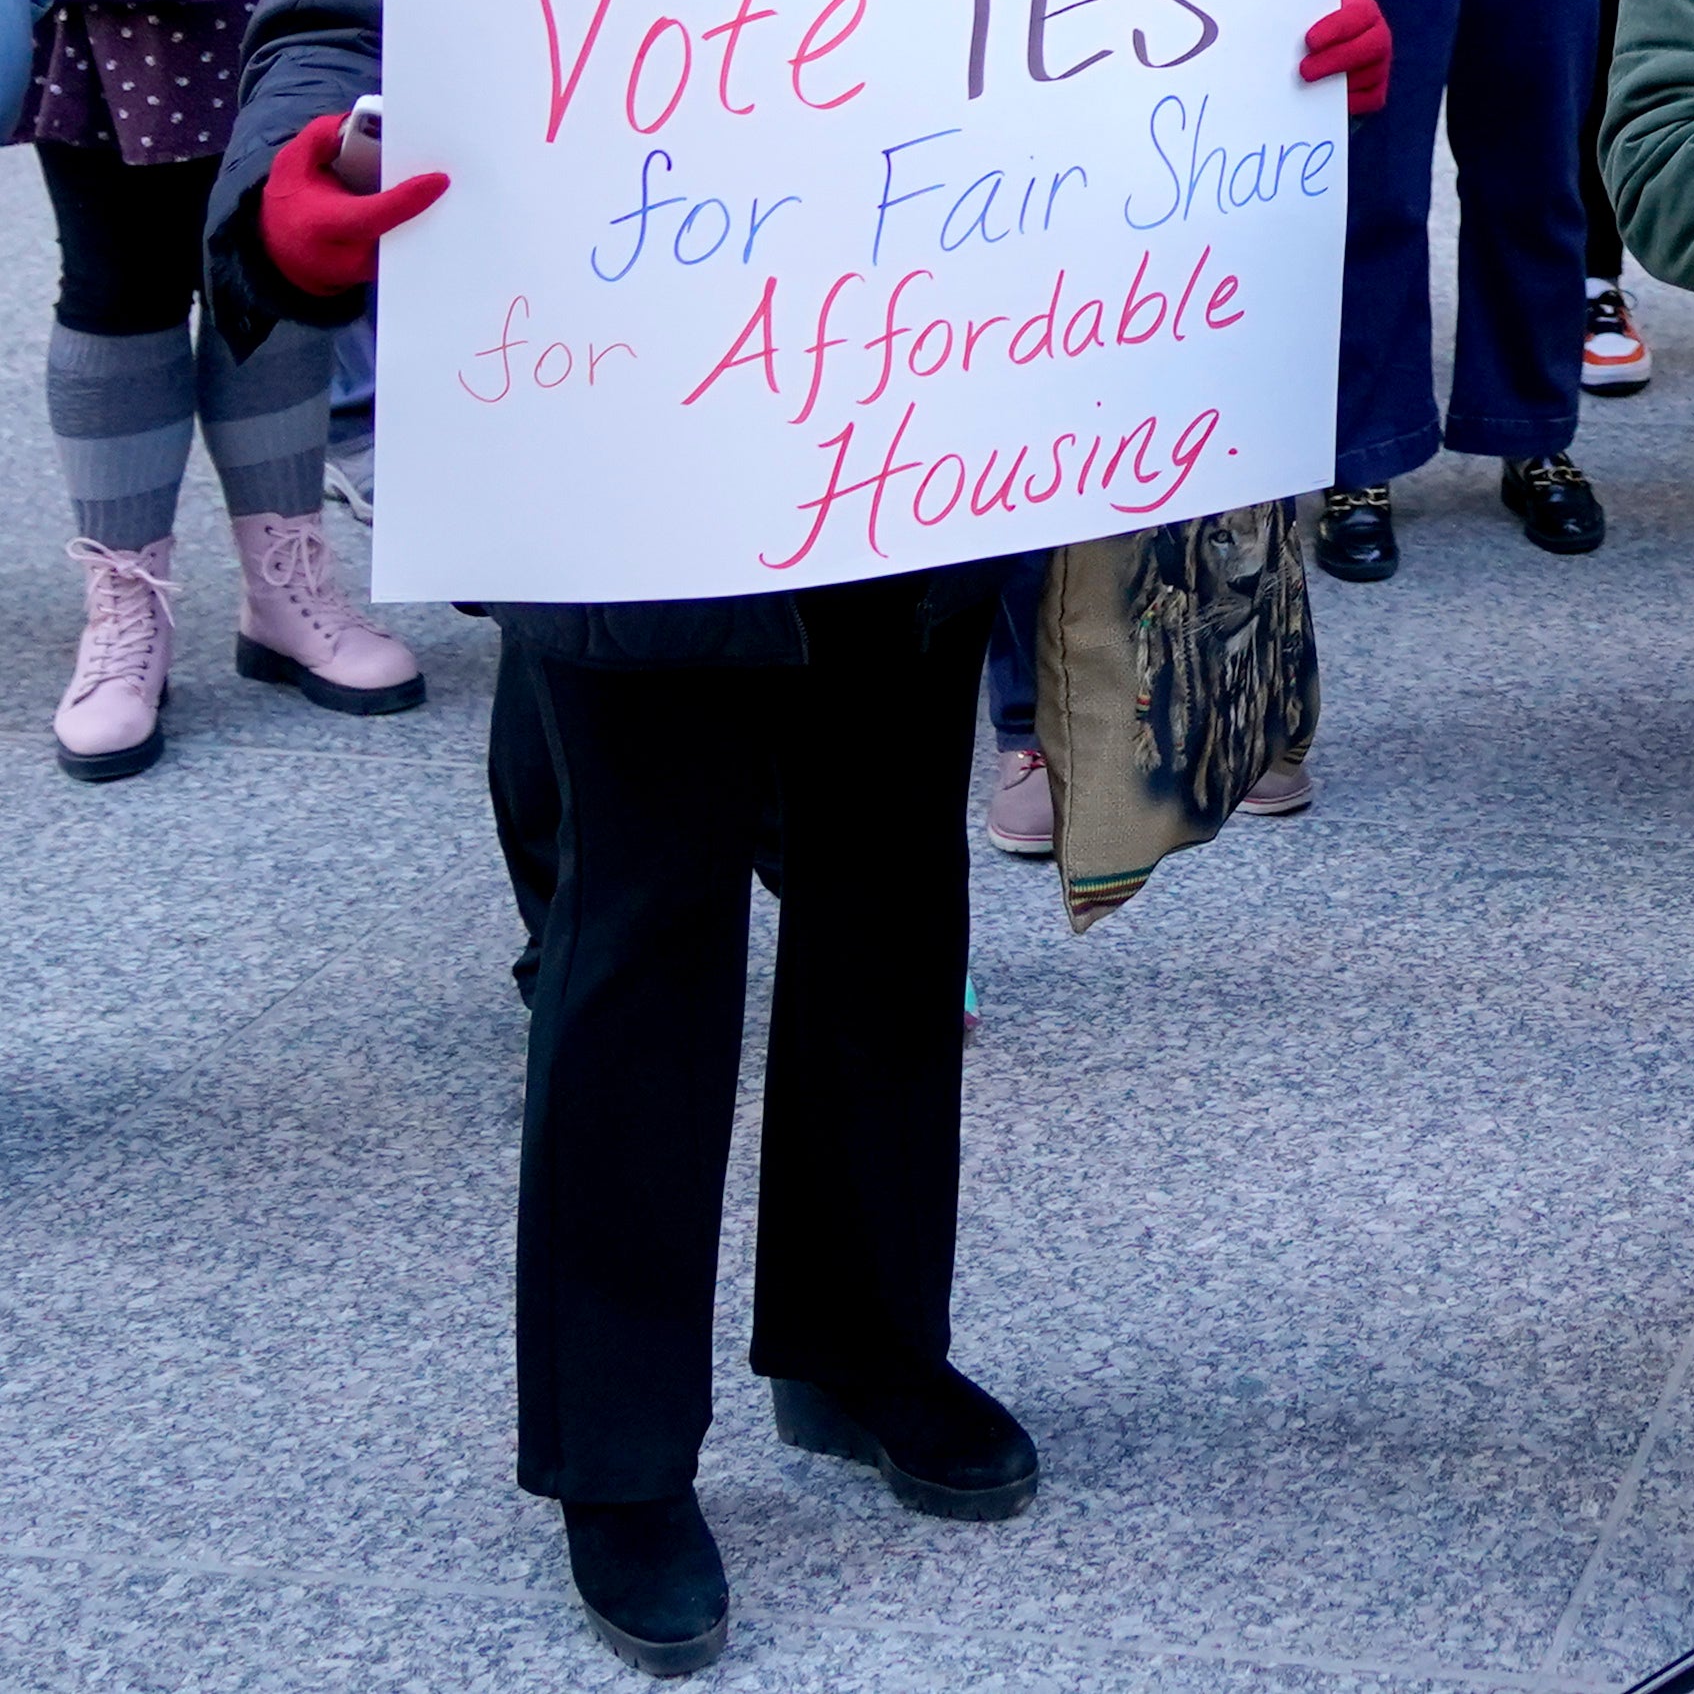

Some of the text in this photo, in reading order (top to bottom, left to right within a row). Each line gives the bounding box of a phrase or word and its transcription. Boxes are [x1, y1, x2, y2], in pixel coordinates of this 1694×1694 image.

[590, 93, 1337, 282] for Fair Share
[458, 245, 1247, 425] for Affordable
[758, 401, 1239, 570] Housing.
